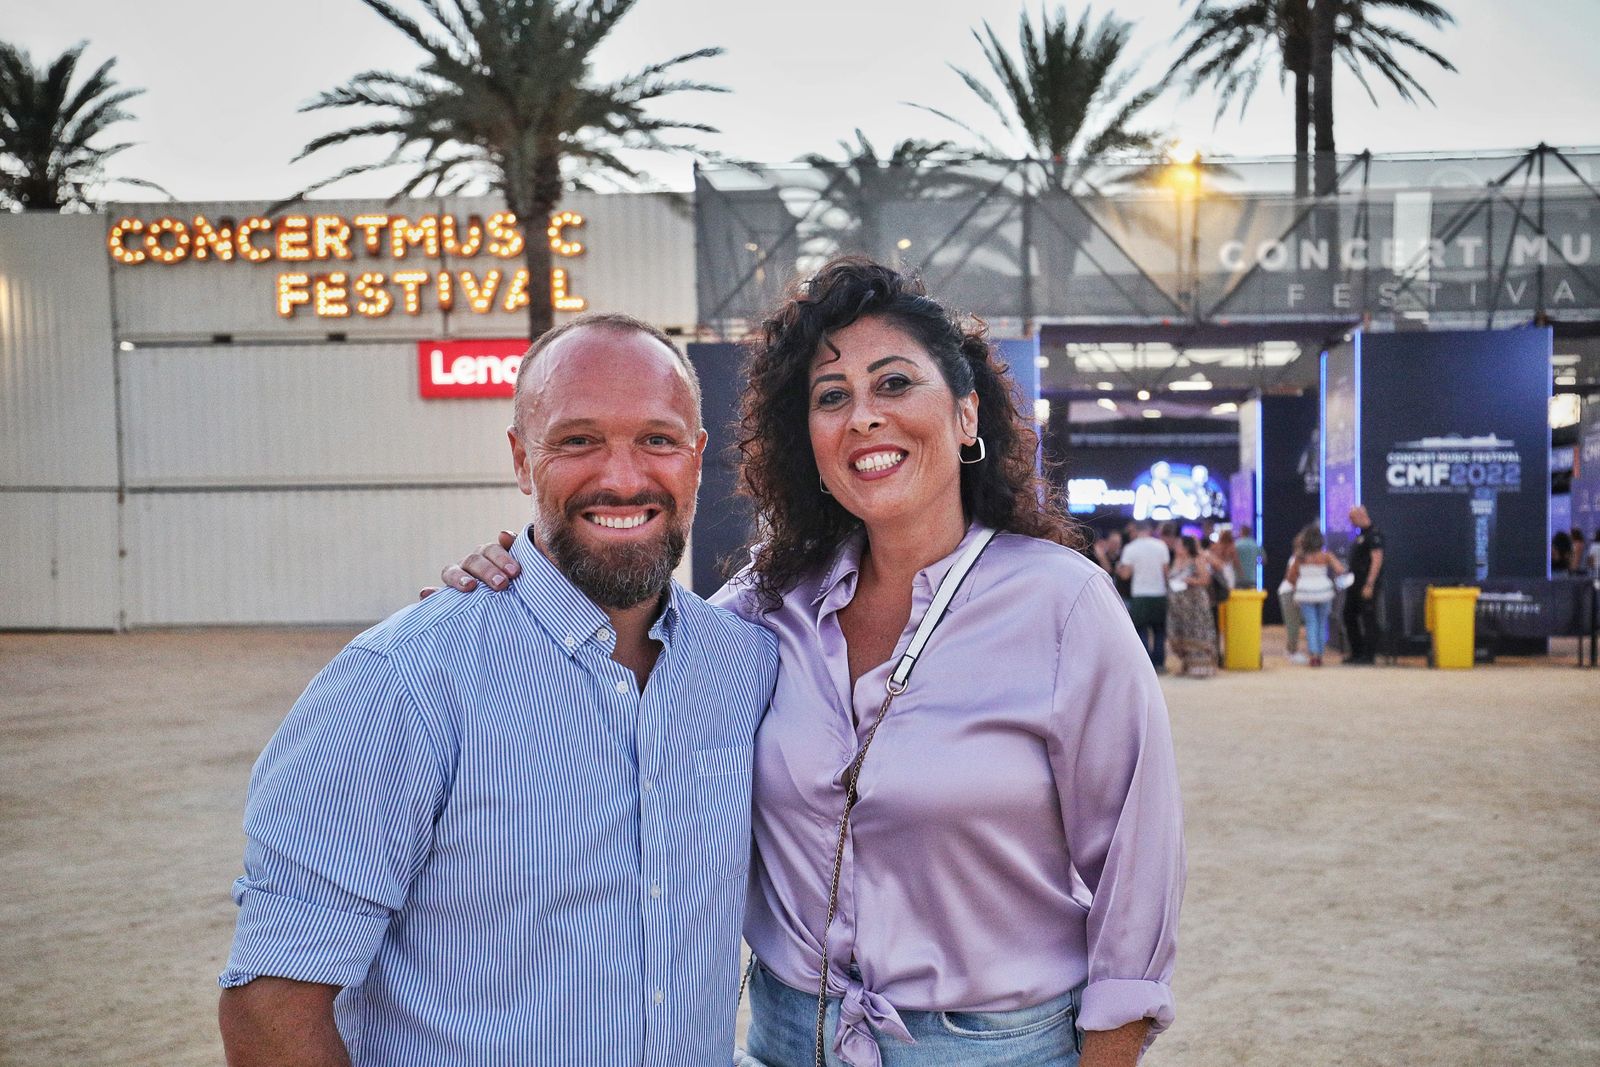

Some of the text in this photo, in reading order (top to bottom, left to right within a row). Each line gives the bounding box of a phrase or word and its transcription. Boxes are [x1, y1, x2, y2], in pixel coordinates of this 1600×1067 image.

[107, 211, 586, 264] CONCERTMUSC
[1512, 233, 1592, 266] MU
[1386, 463, 1522, 487] CMF2022
